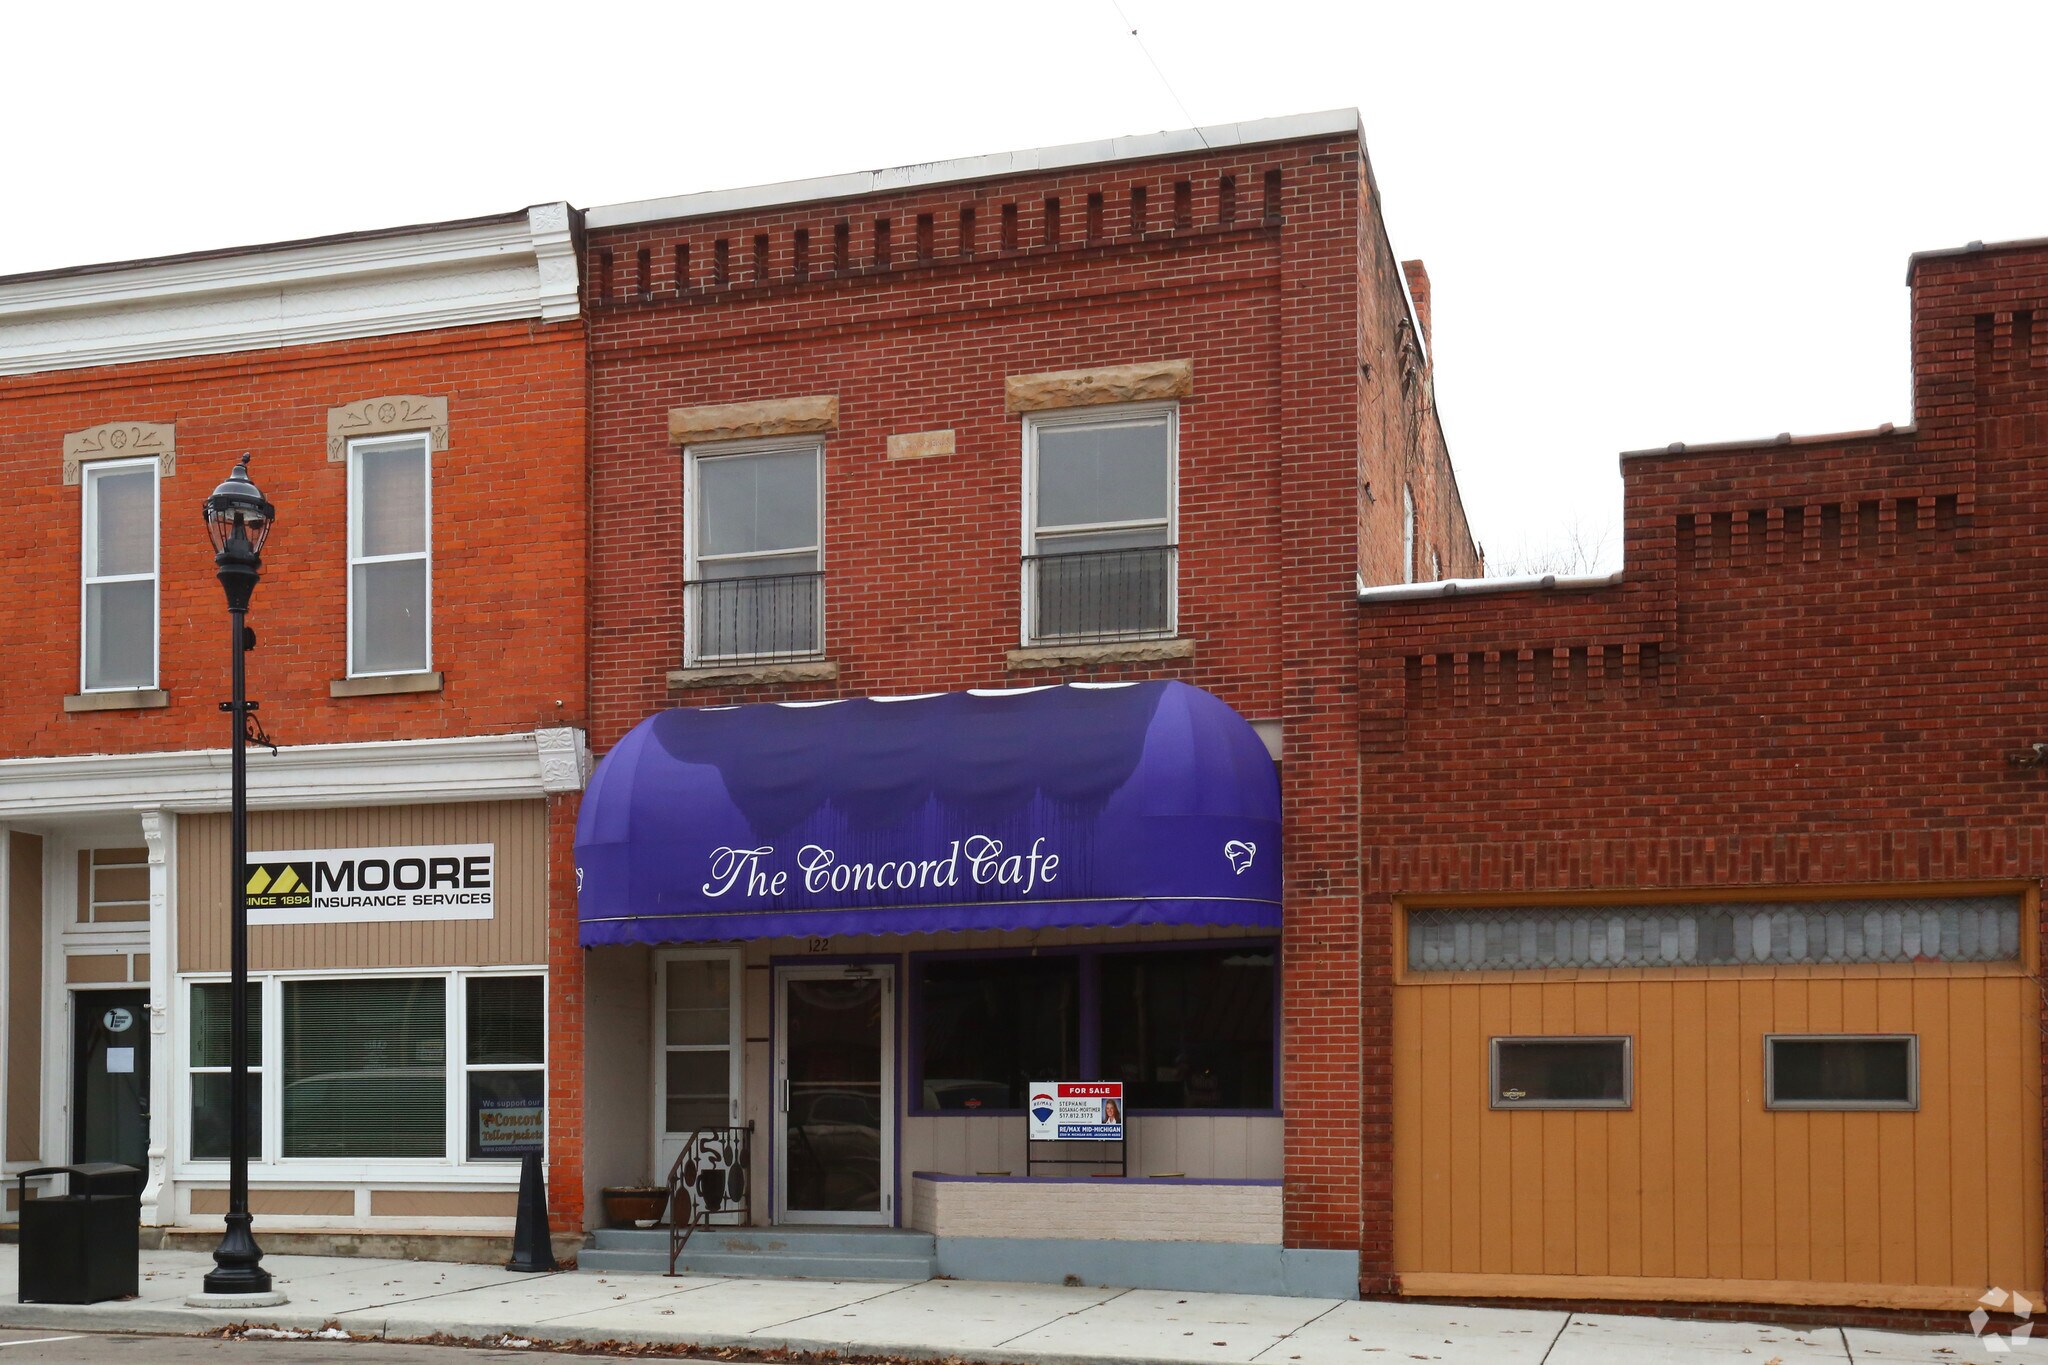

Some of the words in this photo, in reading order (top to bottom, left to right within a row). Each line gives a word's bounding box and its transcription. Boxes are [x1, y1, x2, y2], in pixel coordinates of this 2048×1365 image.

[702, 846, 788, 897] The
[797, 840, 961, 894] Concord
[964, 834, 1060, 895] Cafe
[314, 856, 491, 893] MOORE
[281, 895, 311, 905] 1894
[314, 895, 406, 908] INSURANCE
[412, 893, 491, 906] SERVICES
[808, 938, 829, 952] 122
[495, 1110, 542, 1127] Concord
